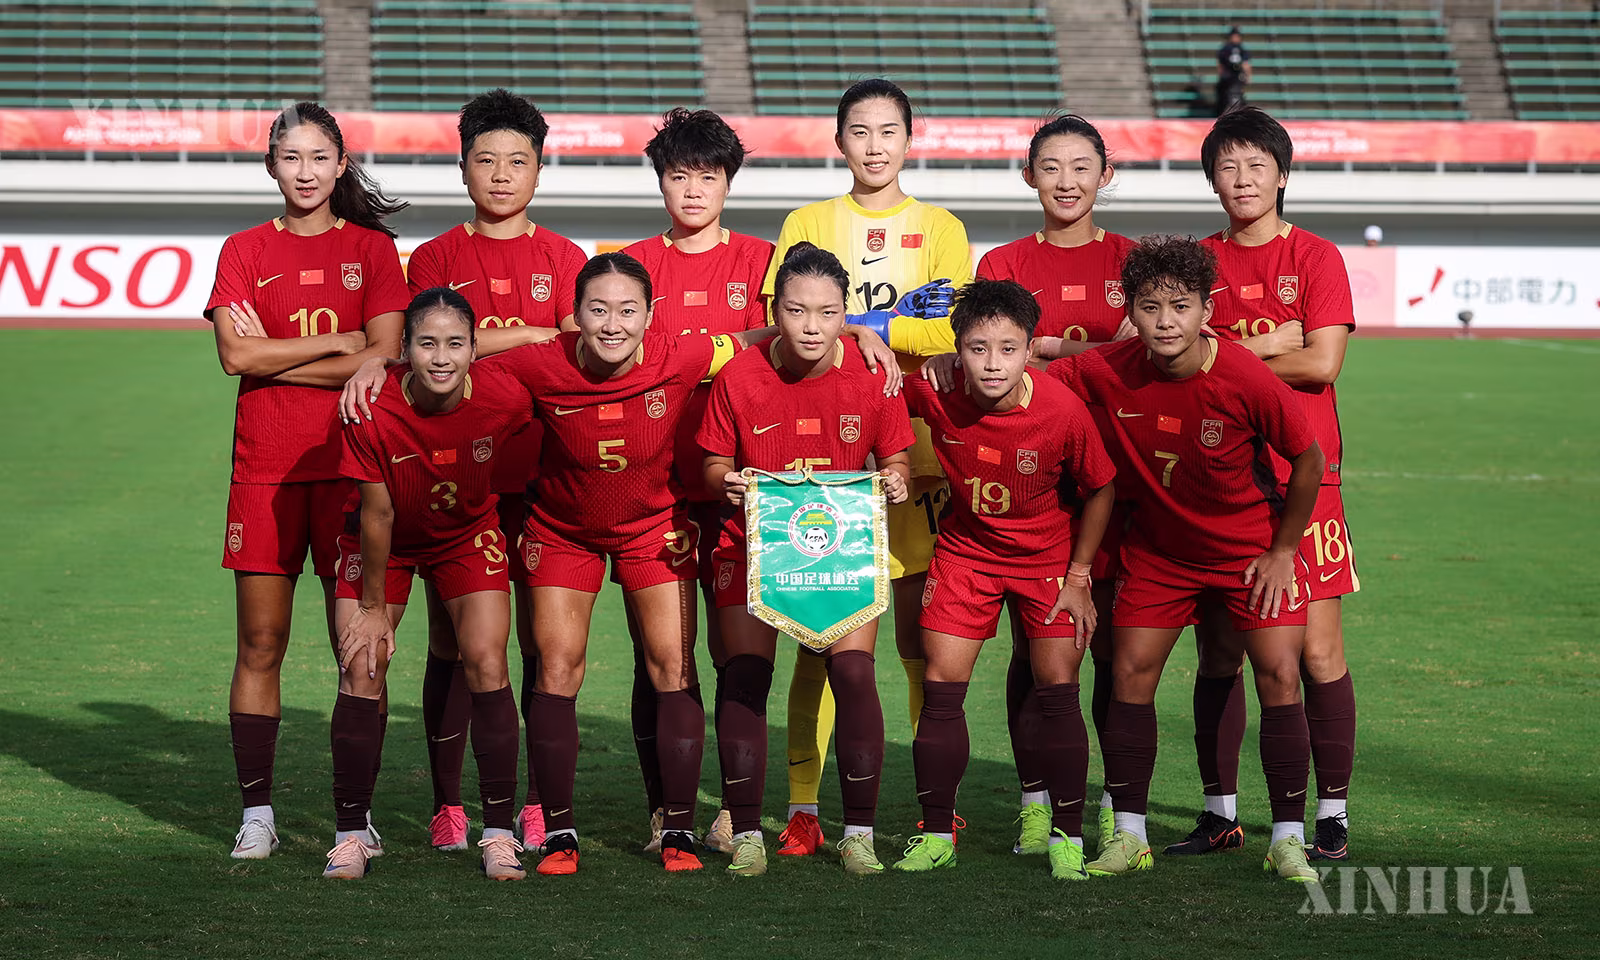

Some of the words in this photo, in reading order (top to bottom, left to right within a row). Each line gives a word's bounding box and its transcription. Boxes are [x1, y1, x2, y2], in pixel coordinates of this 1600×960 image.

[855, 280, 898, 312] 12
[1453, 278, 1577, 306] 中部電力
[289, 307, 339, 337] 10
[598, 438, 628, 473] 5
[1154, 450, 1180, 488] 7
[430, 480, 458, 511] 3
[963, 476, 1011, 515] 19
[473, 529, 504, 563] 3
[1303, 518, 1346, 567] 18
[776, 571, 860, 585] 中国足球协会
